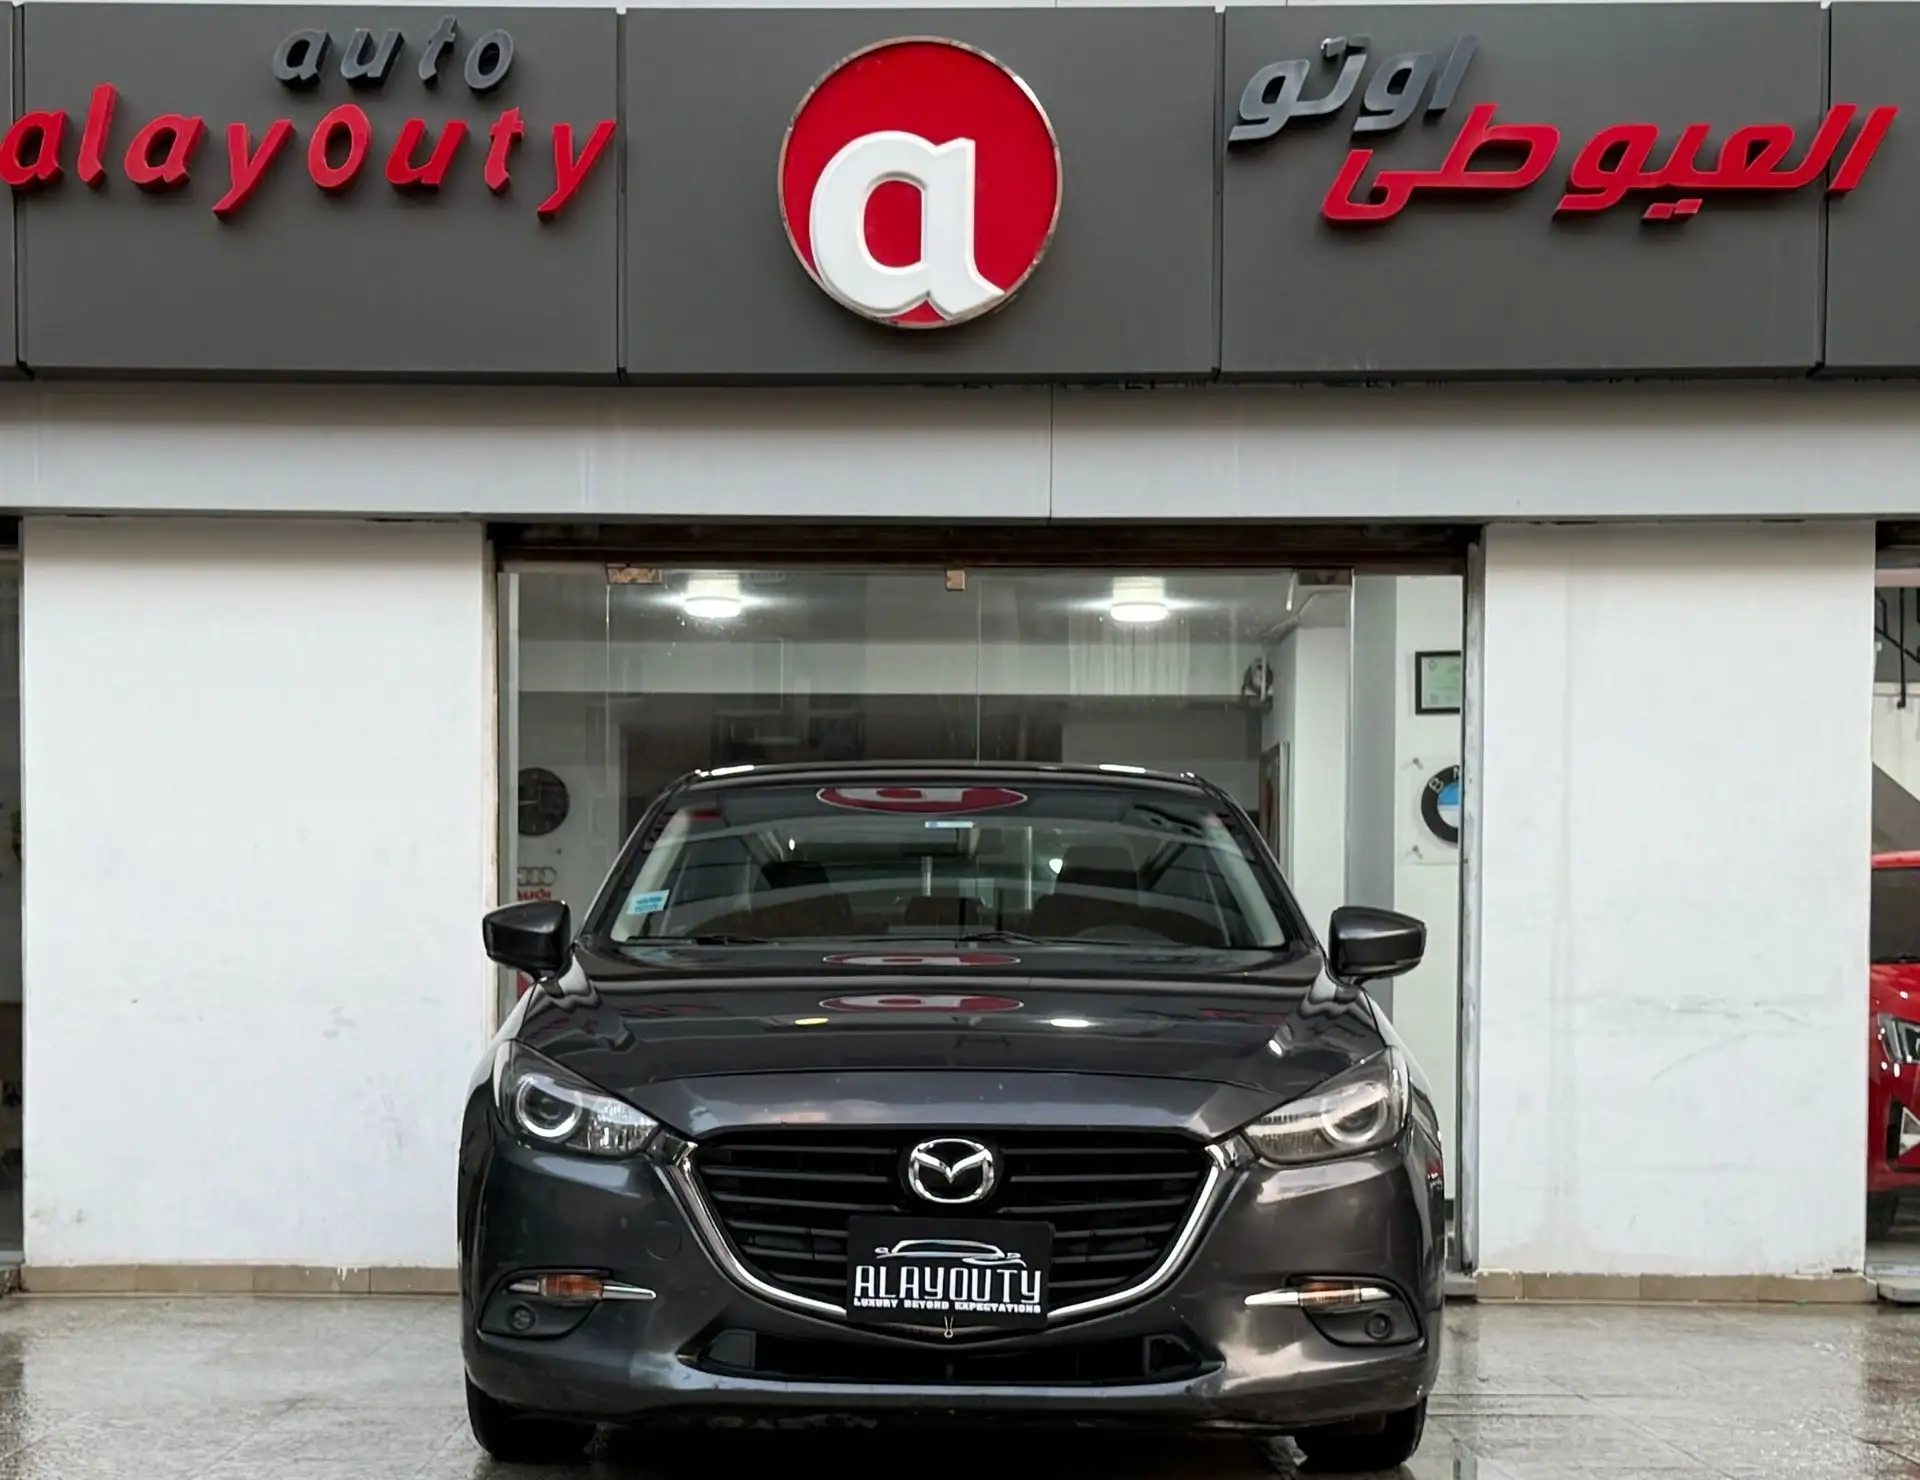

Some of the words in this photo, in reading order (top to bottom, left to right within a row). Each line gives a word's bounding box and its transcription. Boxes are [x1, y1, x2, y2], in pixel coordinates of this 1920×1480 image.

[272, 16, 515, 94] auto
[0, 82, 617, 221] alayouty
[809, 130, 1005, 320] a
[853, 1297, 898, 1308] LUXURY
[904, 1299, 949, 1310] BEYOND
[954, 1302, 1041, 1314] EXPECTATIONS
[854, 1265, 1042, 1304] ALAYOUTY
